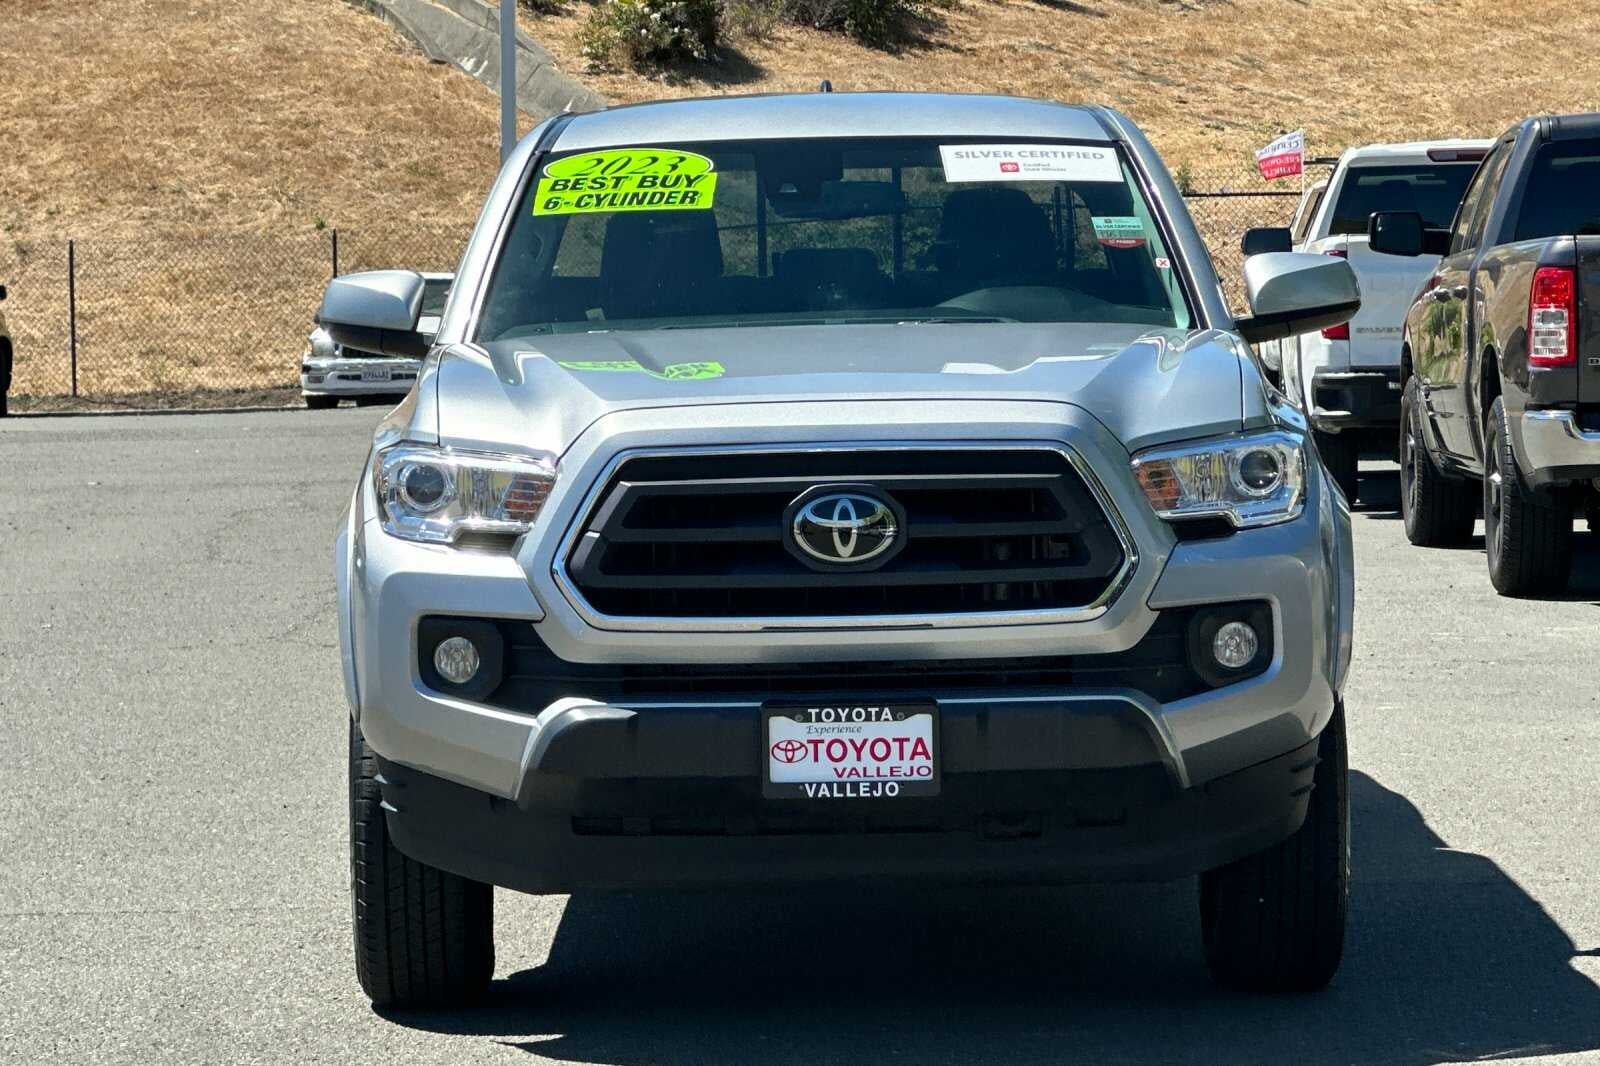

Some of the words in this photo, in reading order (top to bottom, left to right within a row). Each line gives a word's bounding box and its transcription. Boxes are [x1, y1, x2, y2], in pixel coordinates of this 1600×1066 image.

[954, 150, 1014, 159] SILVER
[1018, 150, 1105, 160] CERTIFIED
[570, 155, 687, 177] 2023
[549, 175, 629, 192] BEST
[637, 174, 706, 189] BUY
[543, 190, 701, 210] 6-CYLINDER
[807, 707, 893, 723] TOYOTA
[806, 725, 862, 735] Experience
[807, 737, 931, 763] TOYOTA
[833, 765, 932, 778] VALLEJO
[805, 781, 899, 798] VALLEJO
